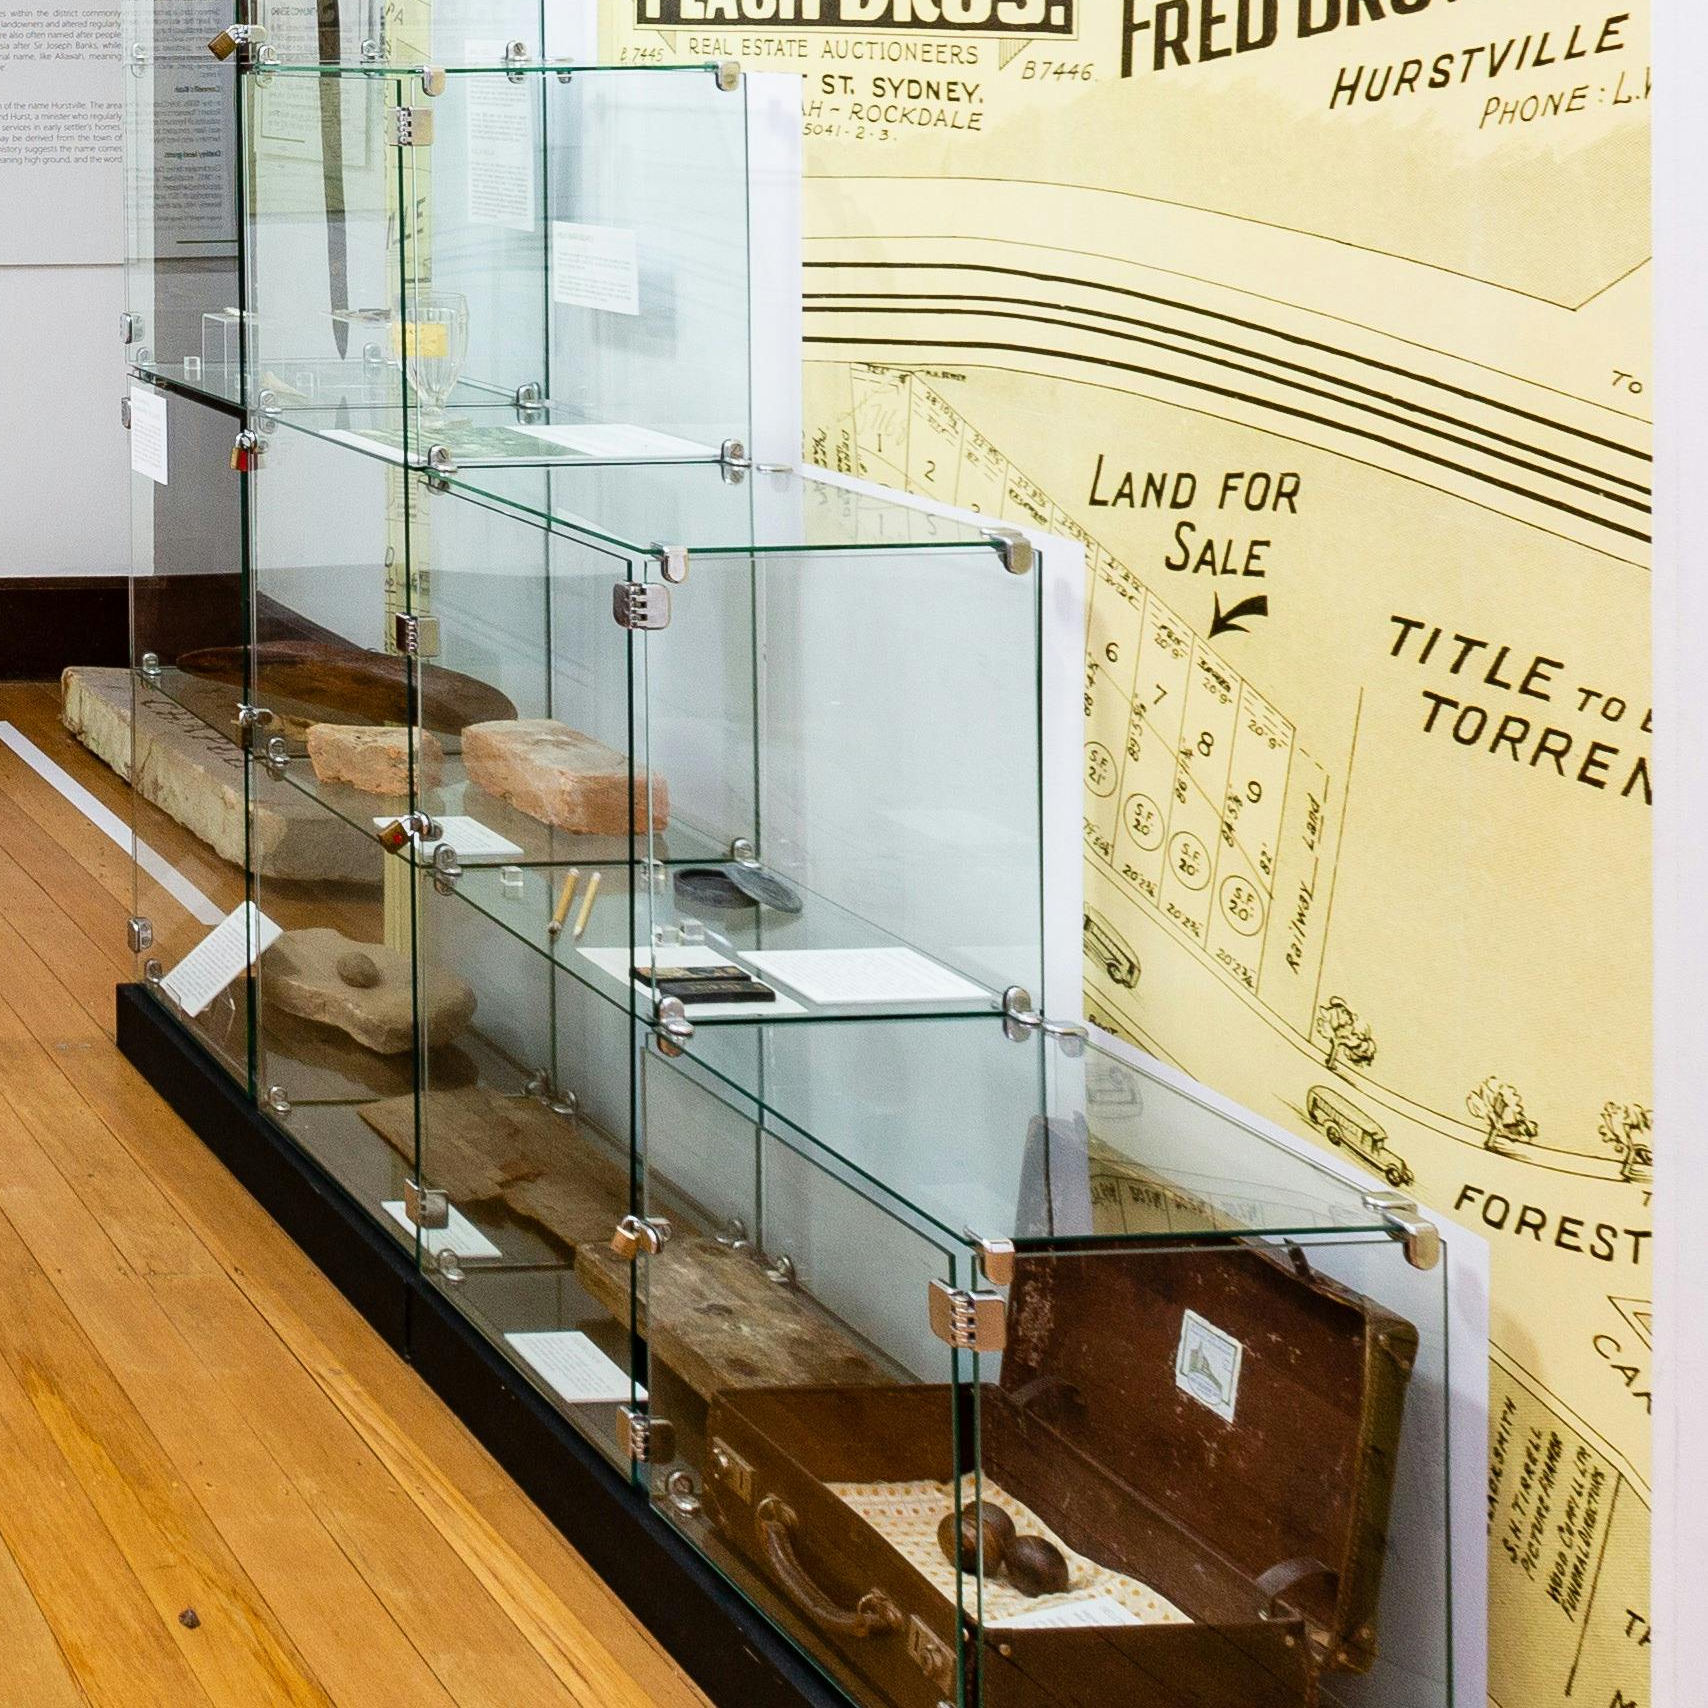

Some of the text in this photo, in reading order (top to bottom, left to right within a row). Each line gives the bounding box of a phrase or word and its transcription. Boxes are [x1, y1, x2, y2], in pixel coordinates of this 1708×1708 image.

[688, 37, 734, 57] REAL
[741, 39, 809, 59] ESTATE
[820, 40, 980, 65] AUCTIONEERS
[1327, 12, 1631, 111] HURSTVILLE
[821, 74, 985, 105] ST. SYDNEY.
[848, 102, 984, 132] ROCKDALE
[1610, 368, 1645, 396] TO
[923, 459, 937, 483] 2
[1088, 453, 1198, 511] LAND
[1217, 470, 1303, 515] FOR
[1164, 520, 1272, 579] SALE
[1105, 642, 1120, 663] 6
[1387, 614, 1627, 724] TITLE TO
[1153, 683, 1168, 705] 7
[1197, 731, 1215, 757] 8
[1246, 780, 1263, 804] 9
[1302, 792, 1321, 852] Land
[1285, 879, 1316, 976] Railway
[1453, 1183, 1653, 1266] FOREST
